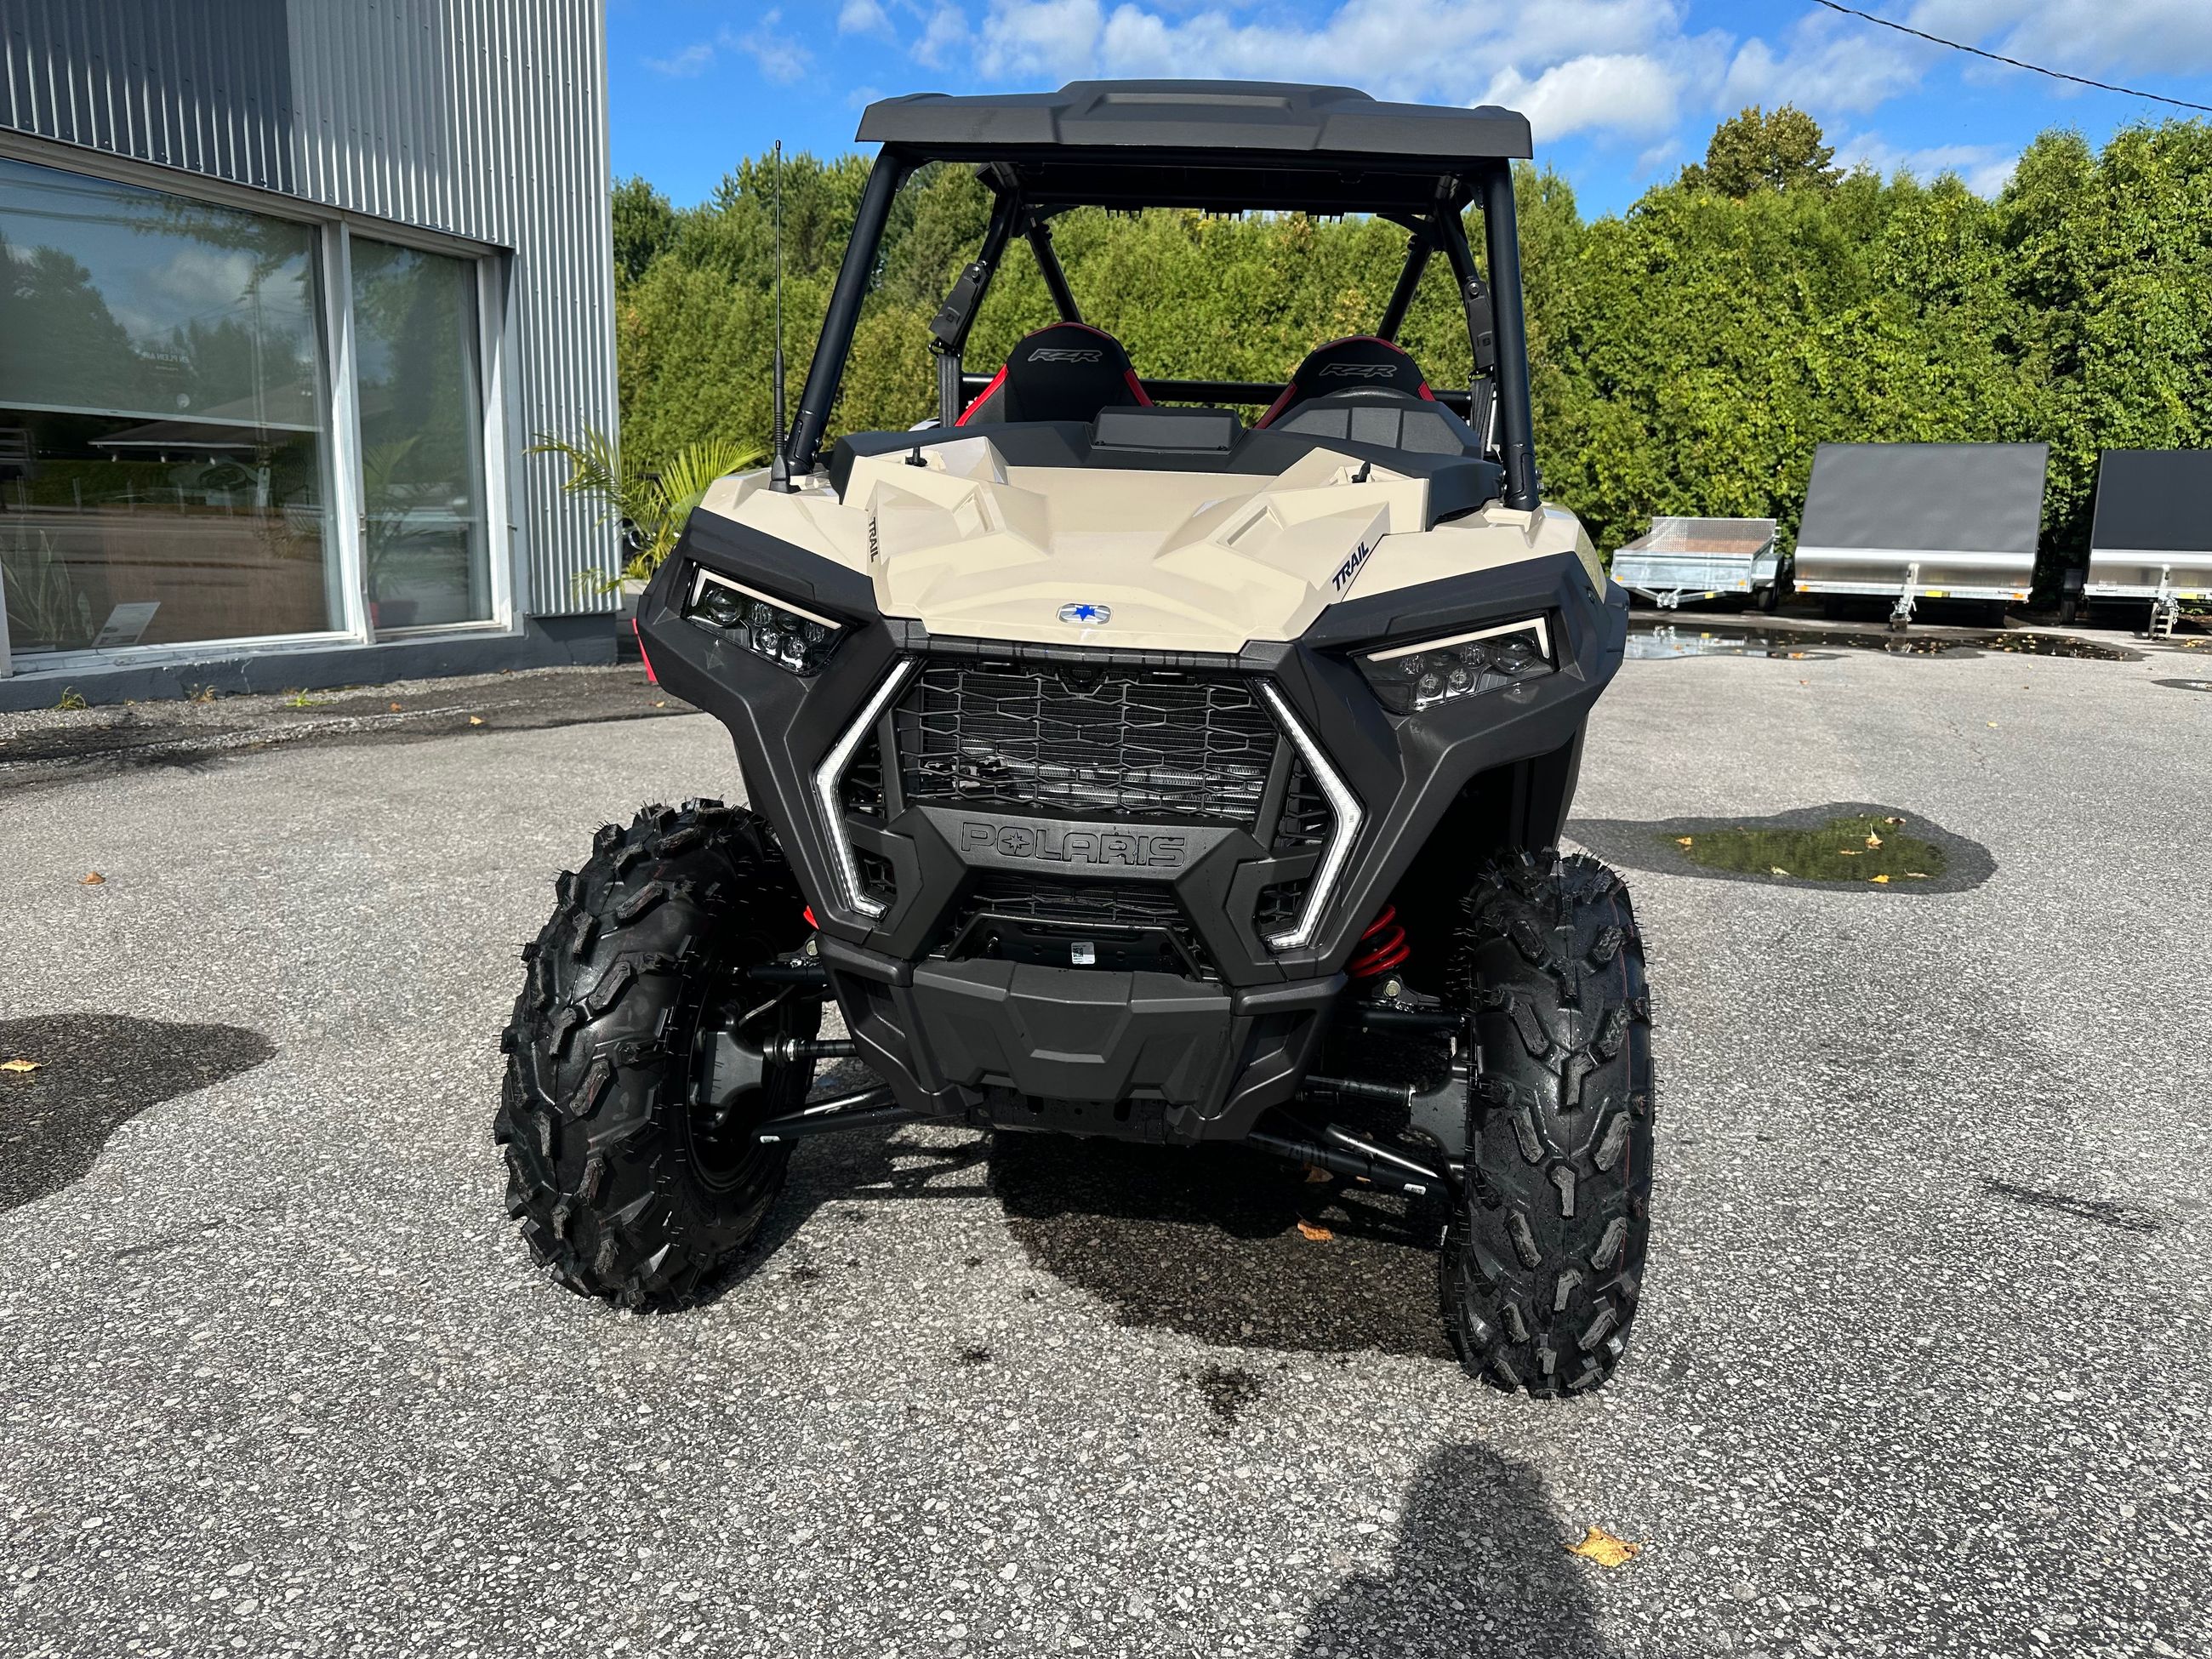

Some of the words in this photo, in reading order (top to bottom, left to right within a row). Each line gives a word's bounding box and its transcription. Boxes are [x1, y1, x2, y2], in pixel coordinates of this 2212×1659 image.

[1028, 348, 1103, 362] RZR
[1319, 363, 1397, 378] RZR
[869, 516, 878, 562] TRAIL
[1332, 541, 1369, 591] TRAIL
[961, 821, 1186, 867] POLARIS
